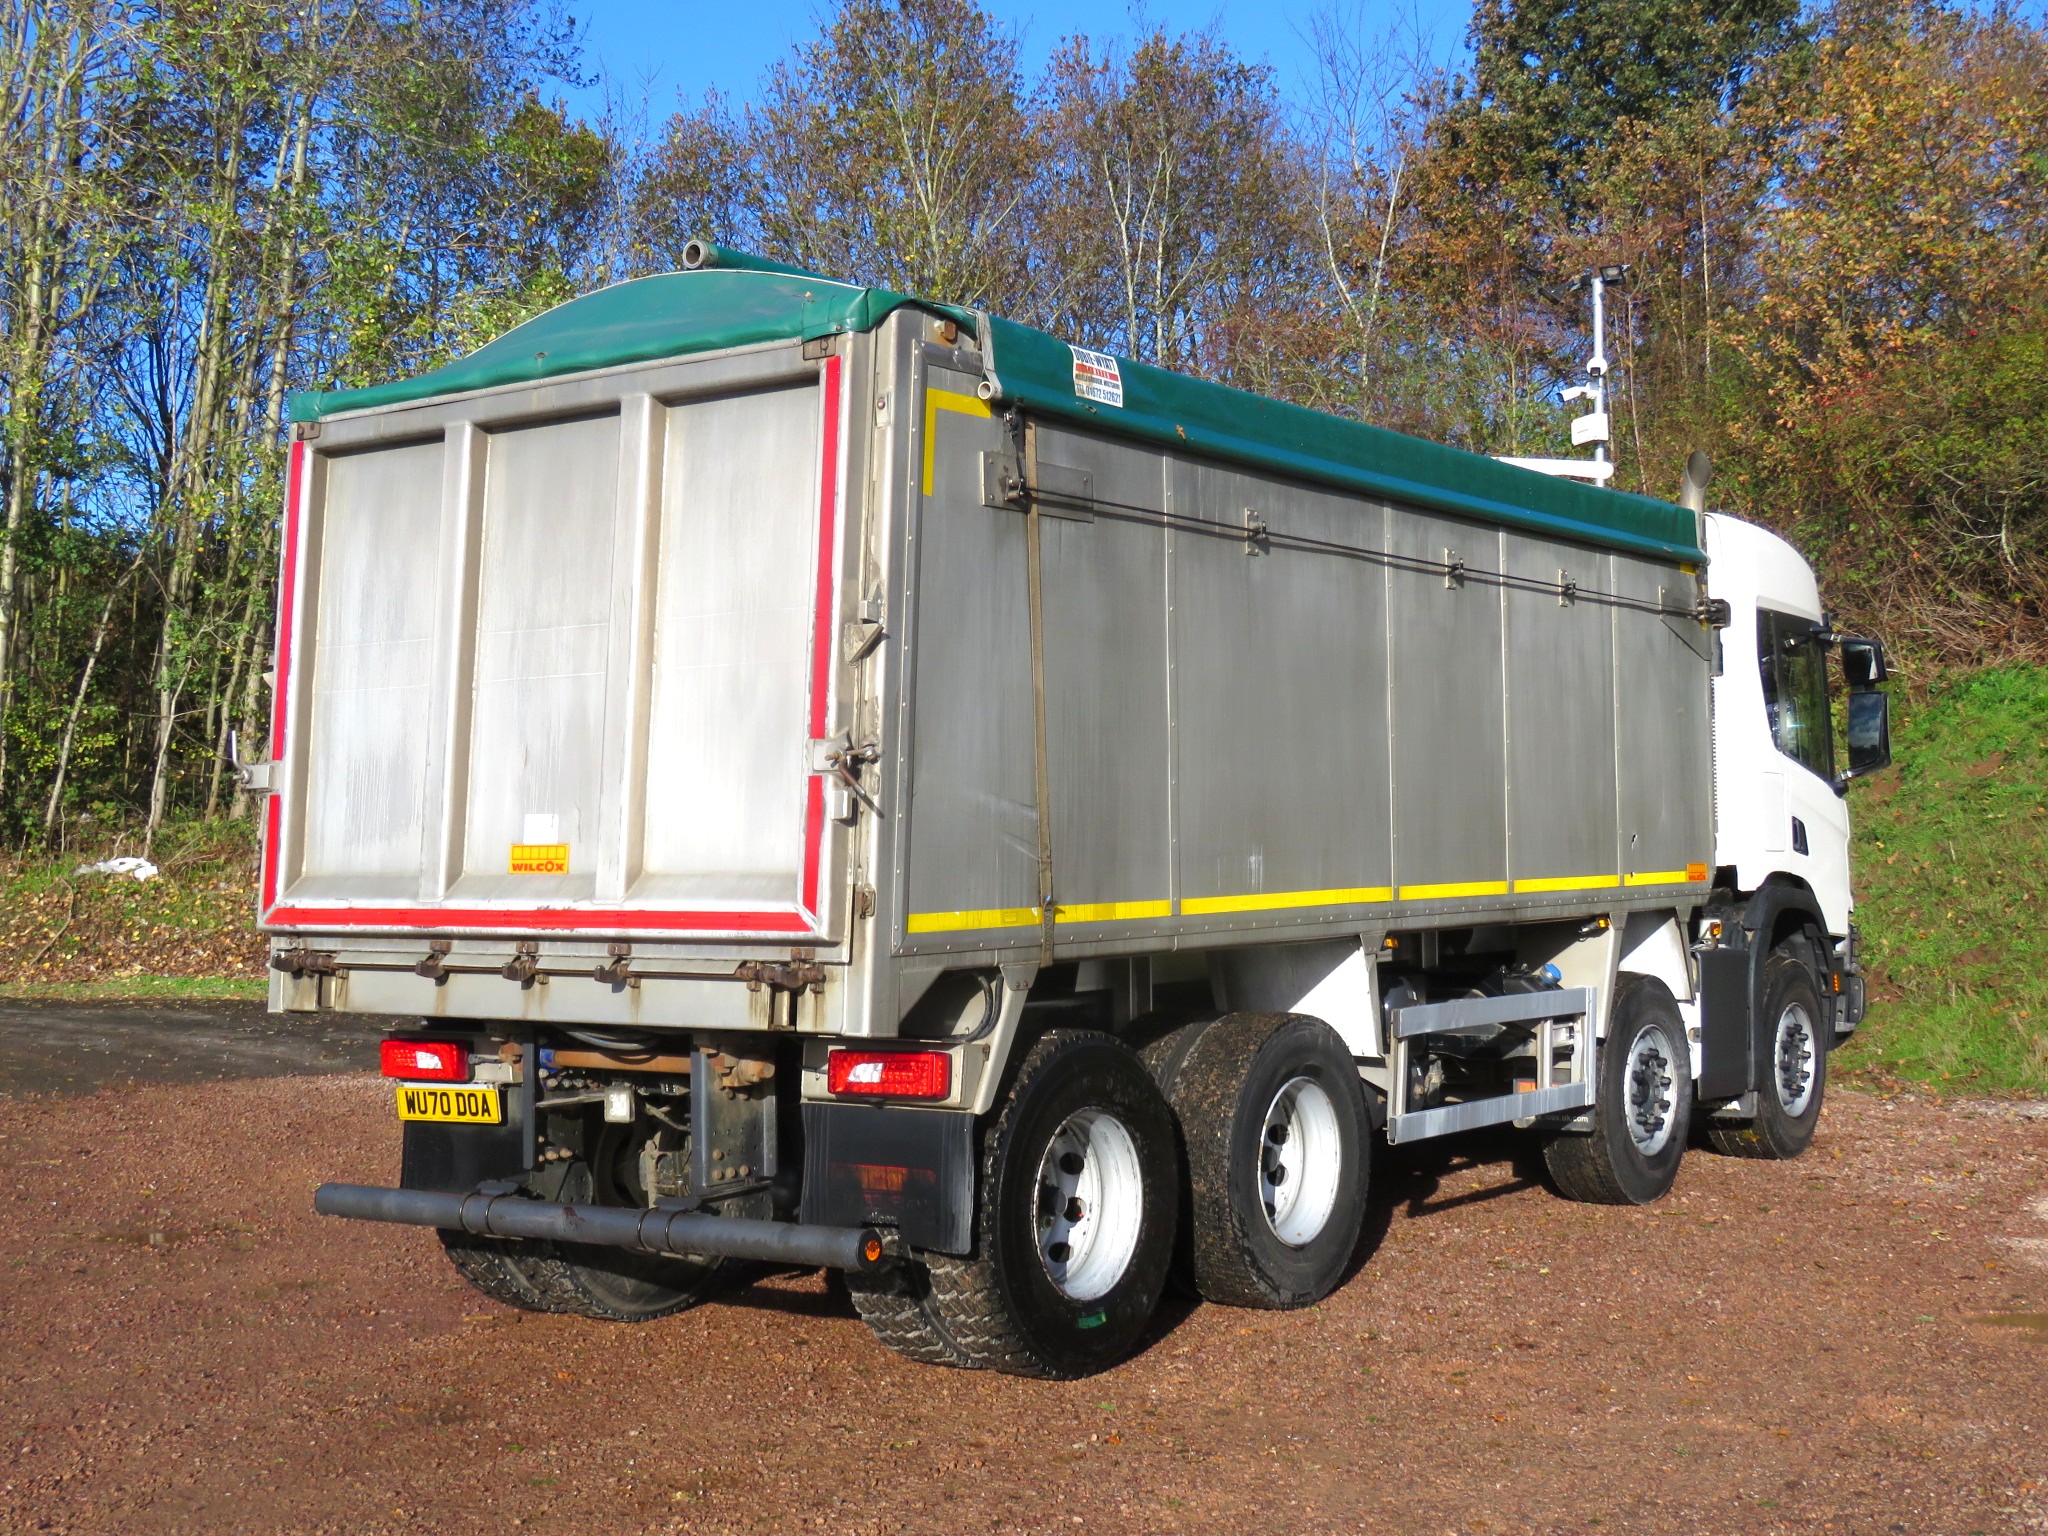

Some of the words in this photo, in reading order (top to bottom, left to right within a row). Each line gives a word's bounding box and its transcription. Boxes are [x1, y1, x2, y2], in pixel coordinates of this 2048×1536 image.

[511, 860, 565, 872] WILCOX
[404, 1090, 451, 1116] WU70
[455, 1092, 491, 1118] DOA
